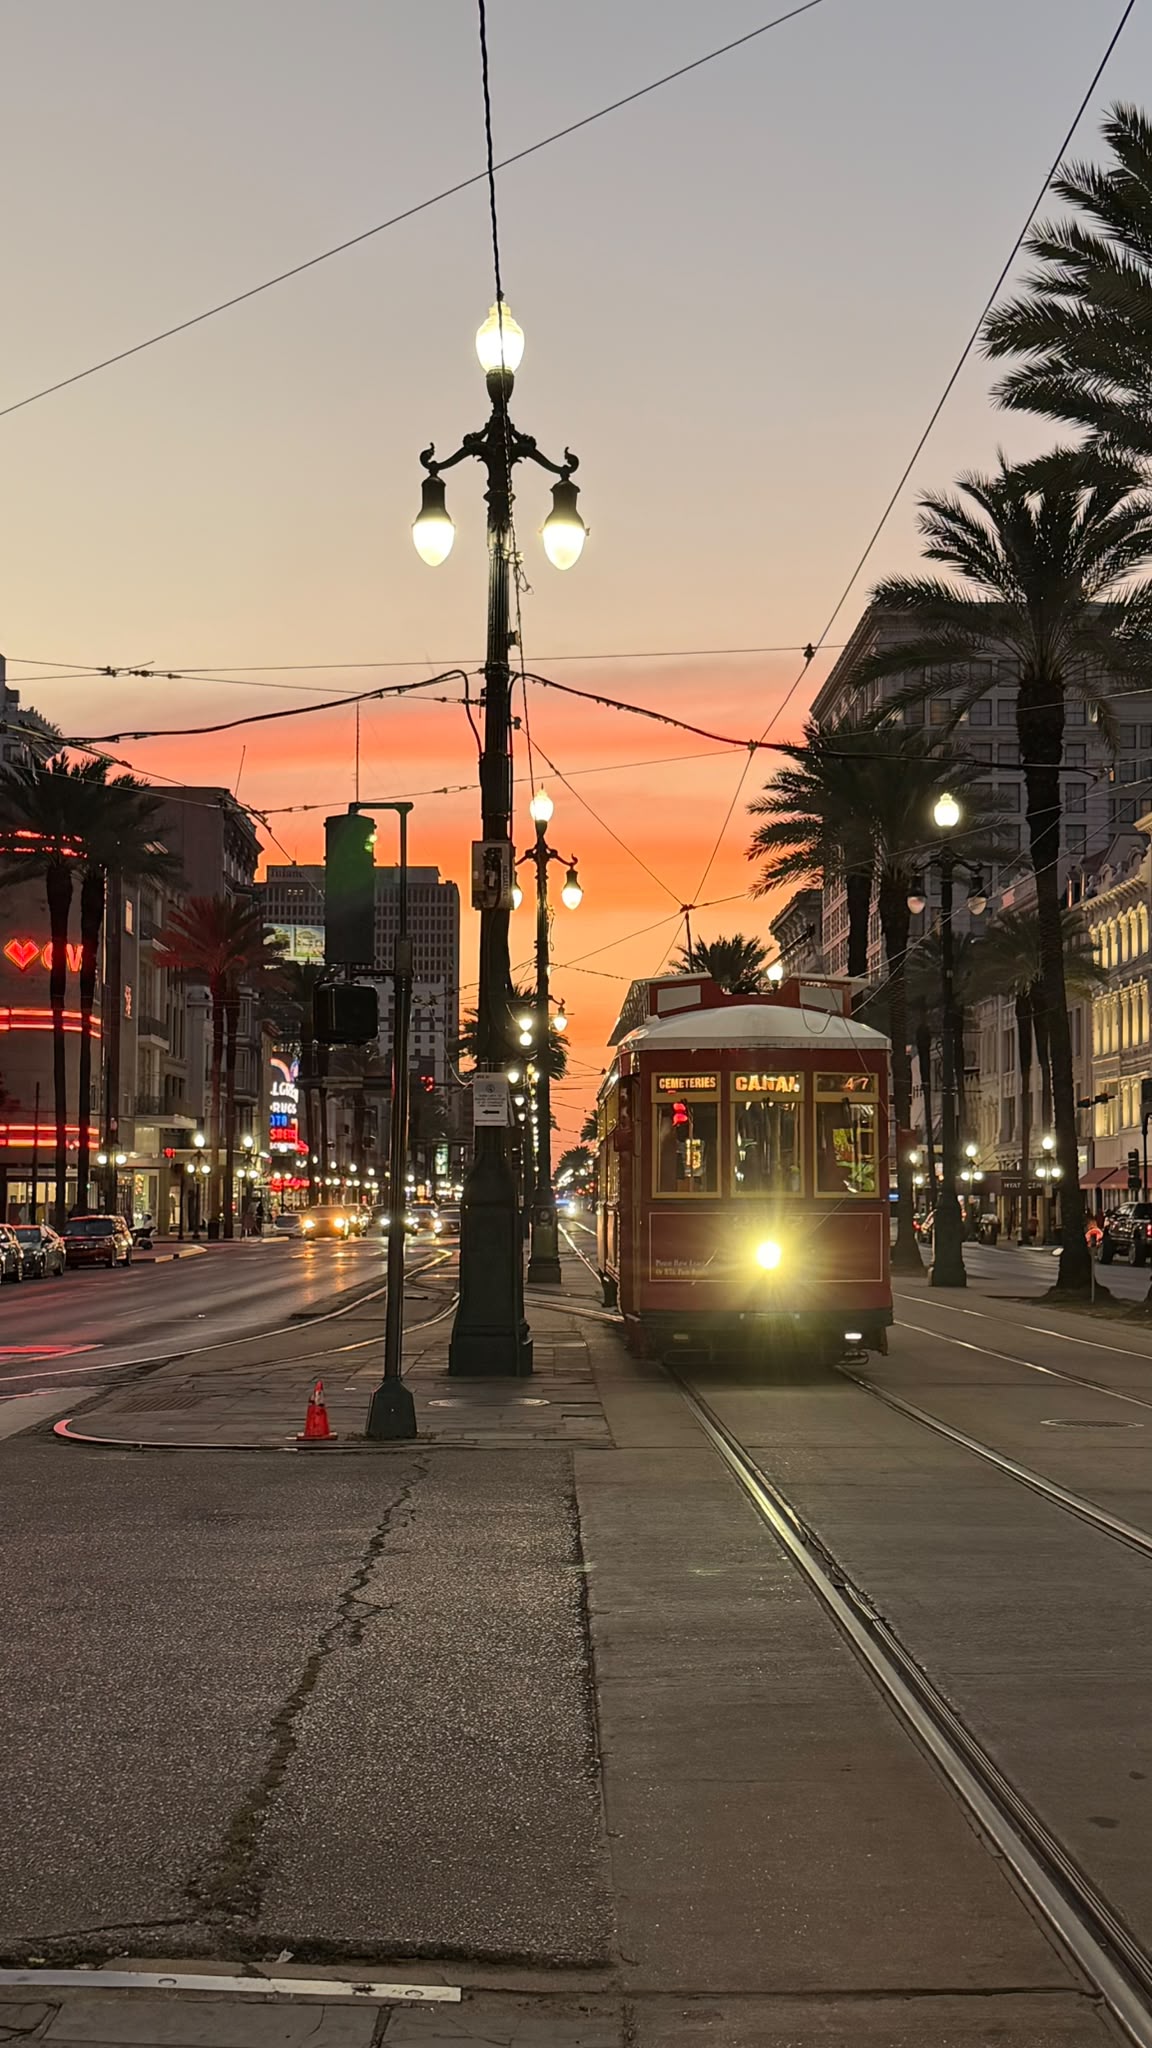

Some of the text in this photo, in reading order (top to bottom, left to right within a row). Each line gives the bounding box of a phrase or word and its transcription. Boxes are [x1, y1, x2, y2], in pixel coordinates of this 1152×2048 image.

[658, 1077, 717, 1090] CEMETERIES
[735, 1075, 799, 1093] CANAL
[270, 1101, 298, 1114] RUGS
